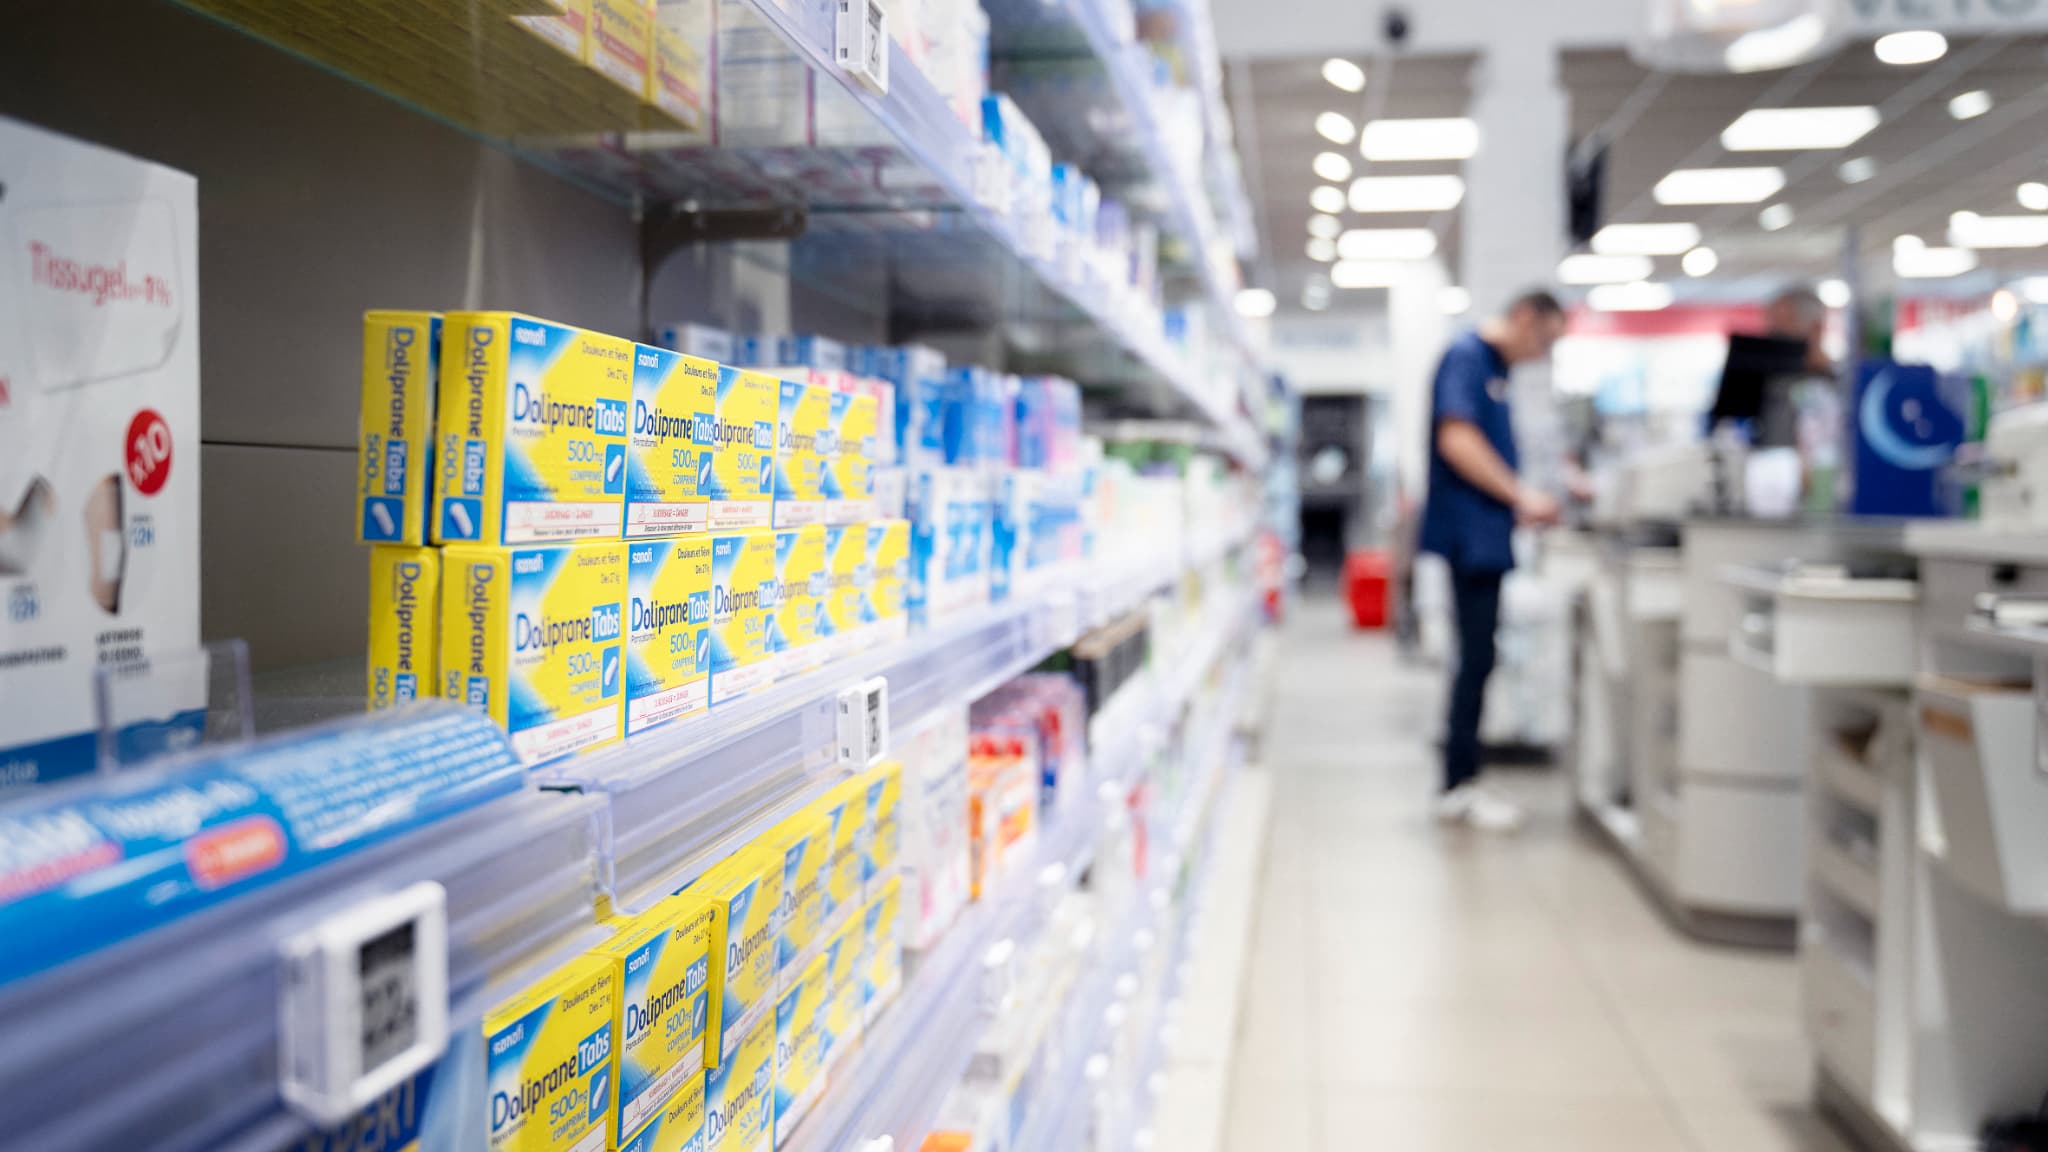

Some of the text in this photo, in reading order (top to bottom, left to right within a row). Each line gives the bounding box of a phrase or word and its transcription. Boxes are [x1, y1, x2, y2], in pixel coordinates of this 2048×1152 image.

[638, 353, 659, 369] sanofi
[387, 327, 415, 491] Doliprane Tabs
[465, 327, 494, 491] Doliprane Tabs
[514, 382, 624, 434] Doliprane Tabs
[634, 399, 714, 444] Doliprane Tabs
[713, 418, 754, 449] oliprane
[632, 548, 653, 564] sanofi
[395, 562, 421, 671] Doliprane
[468, 564, 494, 674] Doliprane
[631, 597, 689, 634] Doliprane
[714, 585, 758, 617] Doliprane
[516, 608, 619, 655] Doliprane Tabs
[628, 947, 650, 974] sanofi
[627, 960, 707, 1040] Doliprane Tabs
[493, 1024, 524, 1057] sanofi
[492, 1055, 577, 1133] Doliprane
[579, 1031, 609, 1071] Tabs
[709, 1082, 754, 1140] Doliprane
